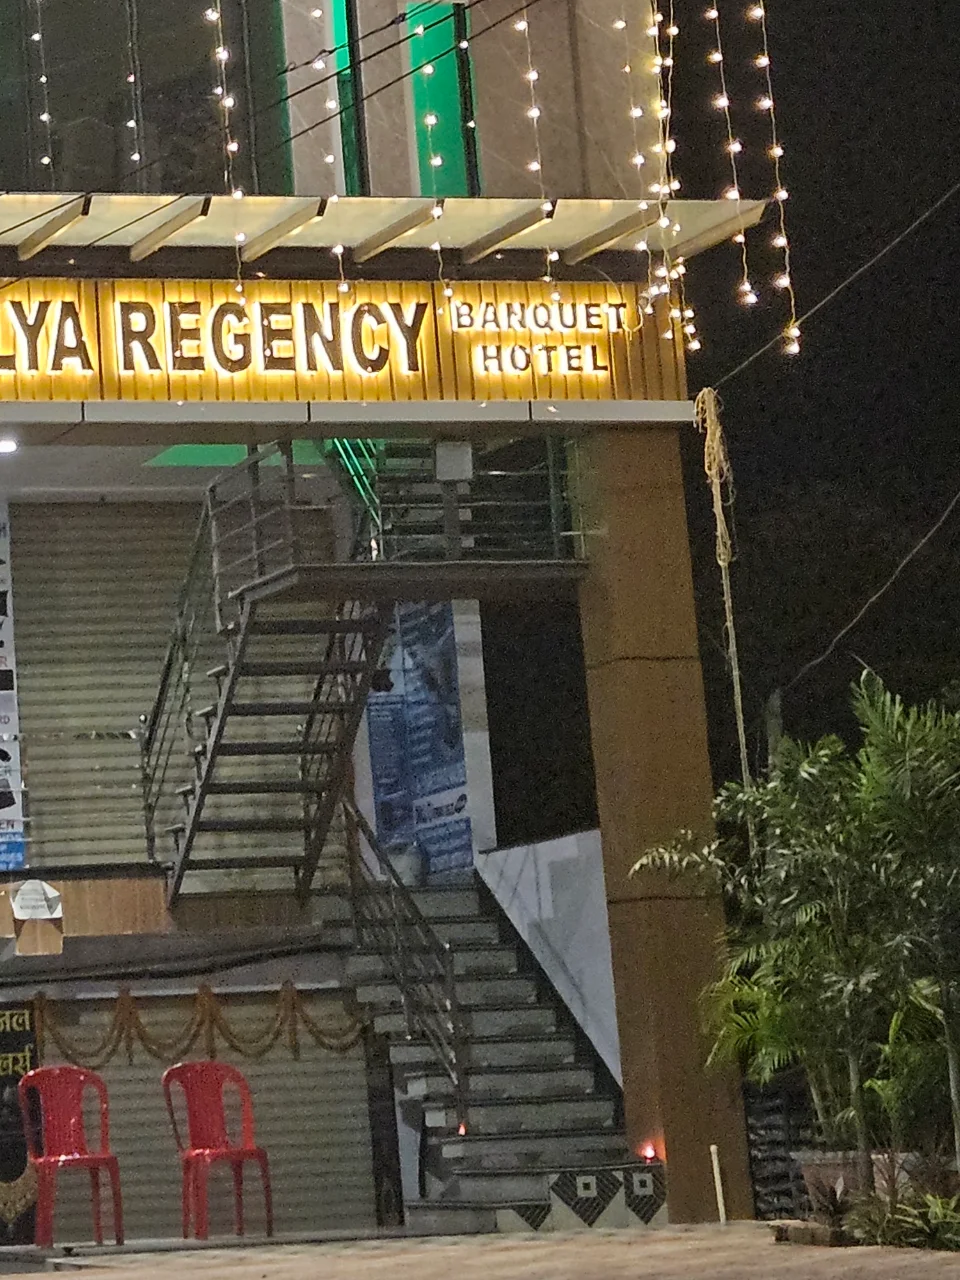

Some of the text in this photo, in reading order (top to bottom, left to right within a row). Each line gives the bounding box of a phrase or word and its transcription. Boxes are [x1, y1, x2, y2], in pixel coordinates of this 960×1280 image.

[454, 302, 628, 332] BANQUET
[119, 300, 429, 374] REGENCY
[481, 344, 609, 373] HOTEL
